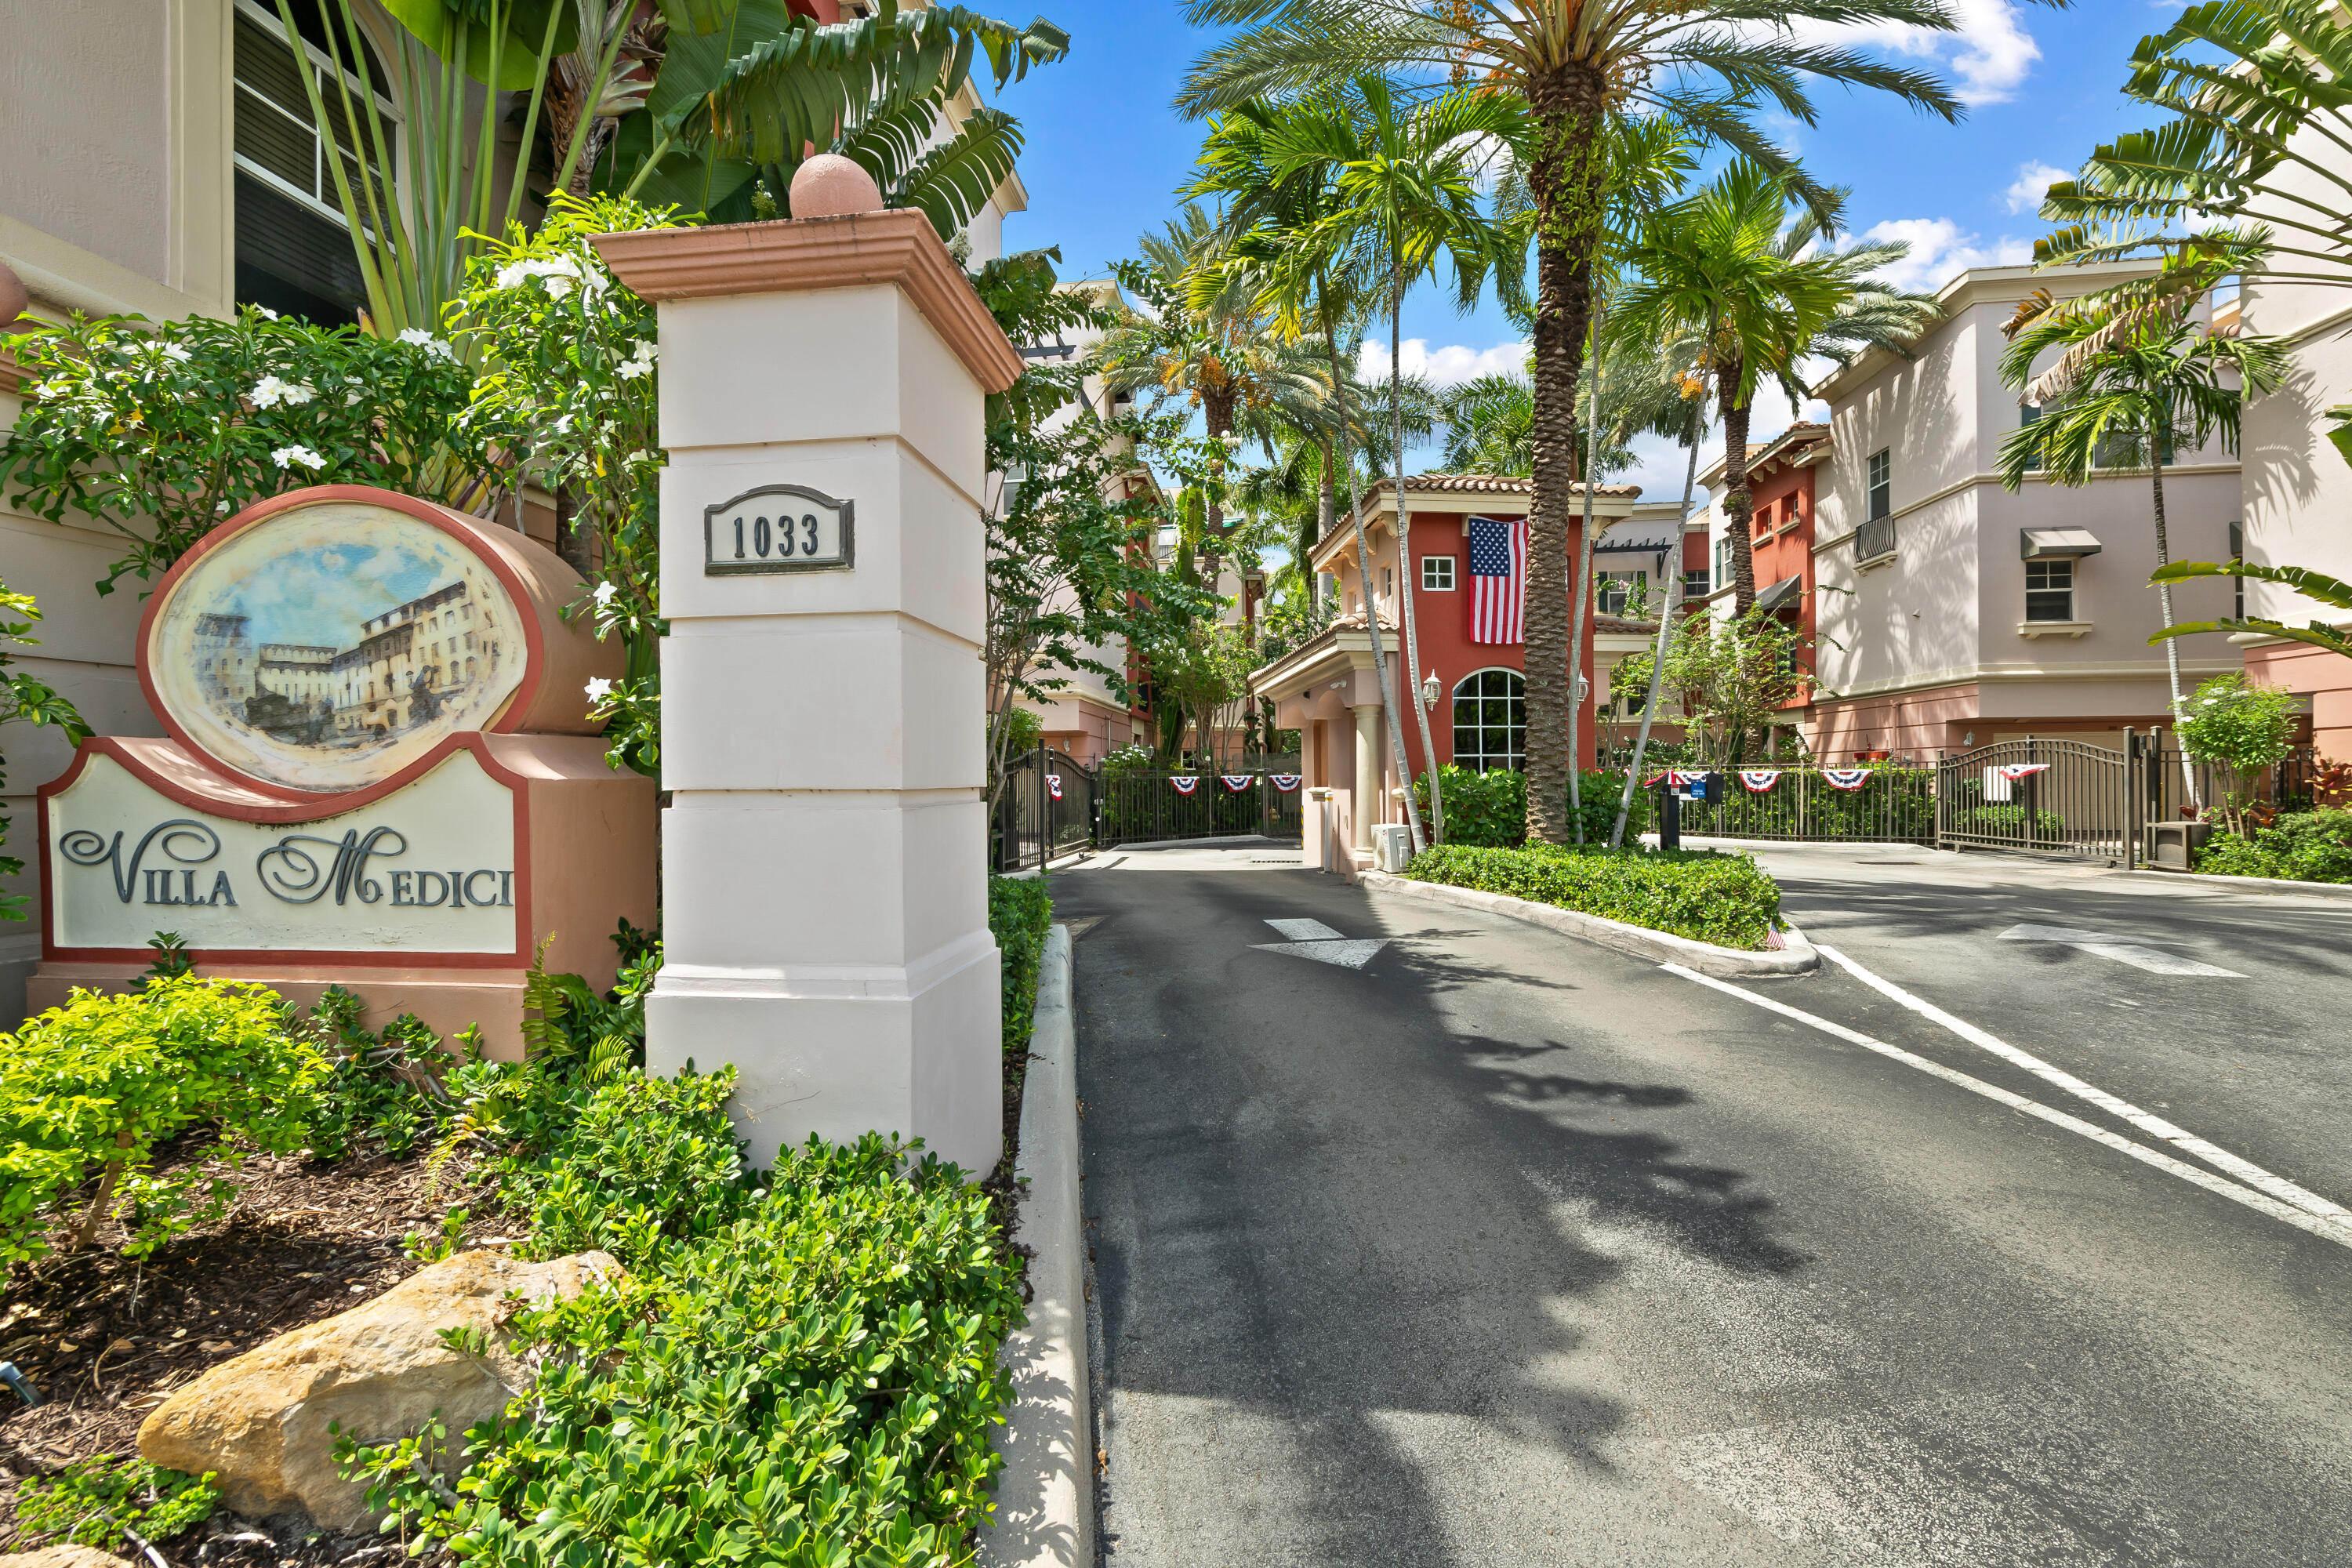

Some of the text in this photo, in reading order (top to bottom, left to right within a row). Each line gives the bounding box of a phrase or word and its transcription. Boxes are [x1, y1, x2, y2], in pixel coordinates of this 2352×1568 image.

[734, 514, 818, 558] 1033
[60, 818, 514, 907] VILLA MEDICI
